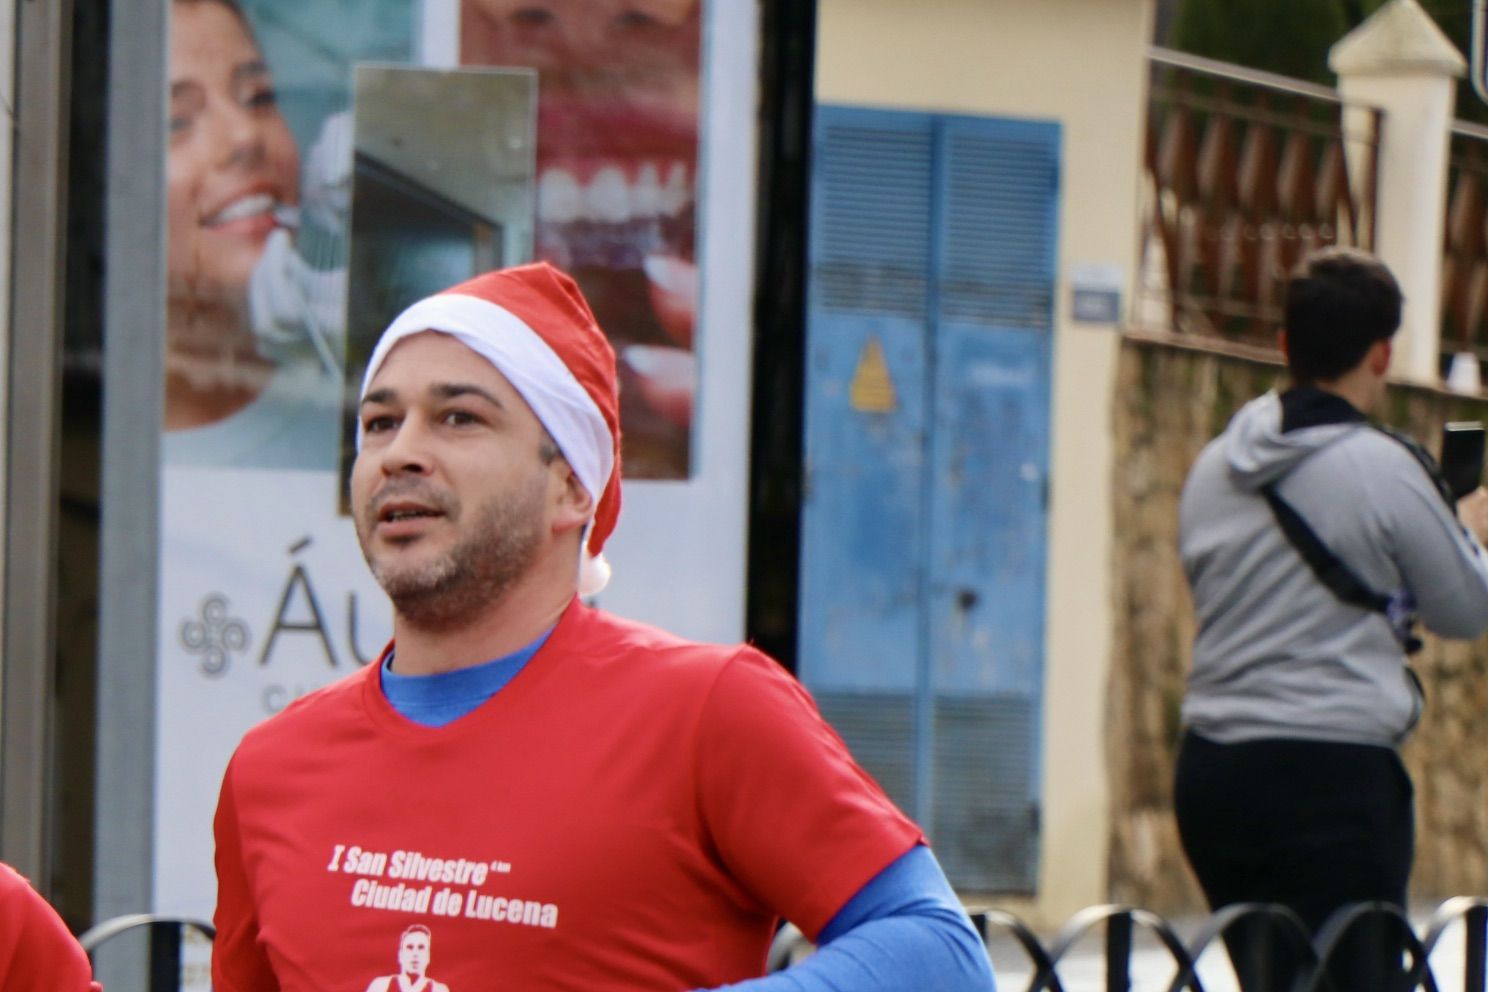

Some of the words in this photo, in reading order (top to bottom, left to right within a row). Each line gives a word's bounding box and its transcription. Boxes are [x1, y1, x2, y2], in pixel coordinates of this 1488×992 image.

[328, 845, 344, 870] I
[344, 847, 387, 875] San
[389, 850, 489, 885] Silvestre
[351, 879, 432, 913] Ciudad
[433, 889, 463, 915] de
[466, 890, 559, 928] Lucena
